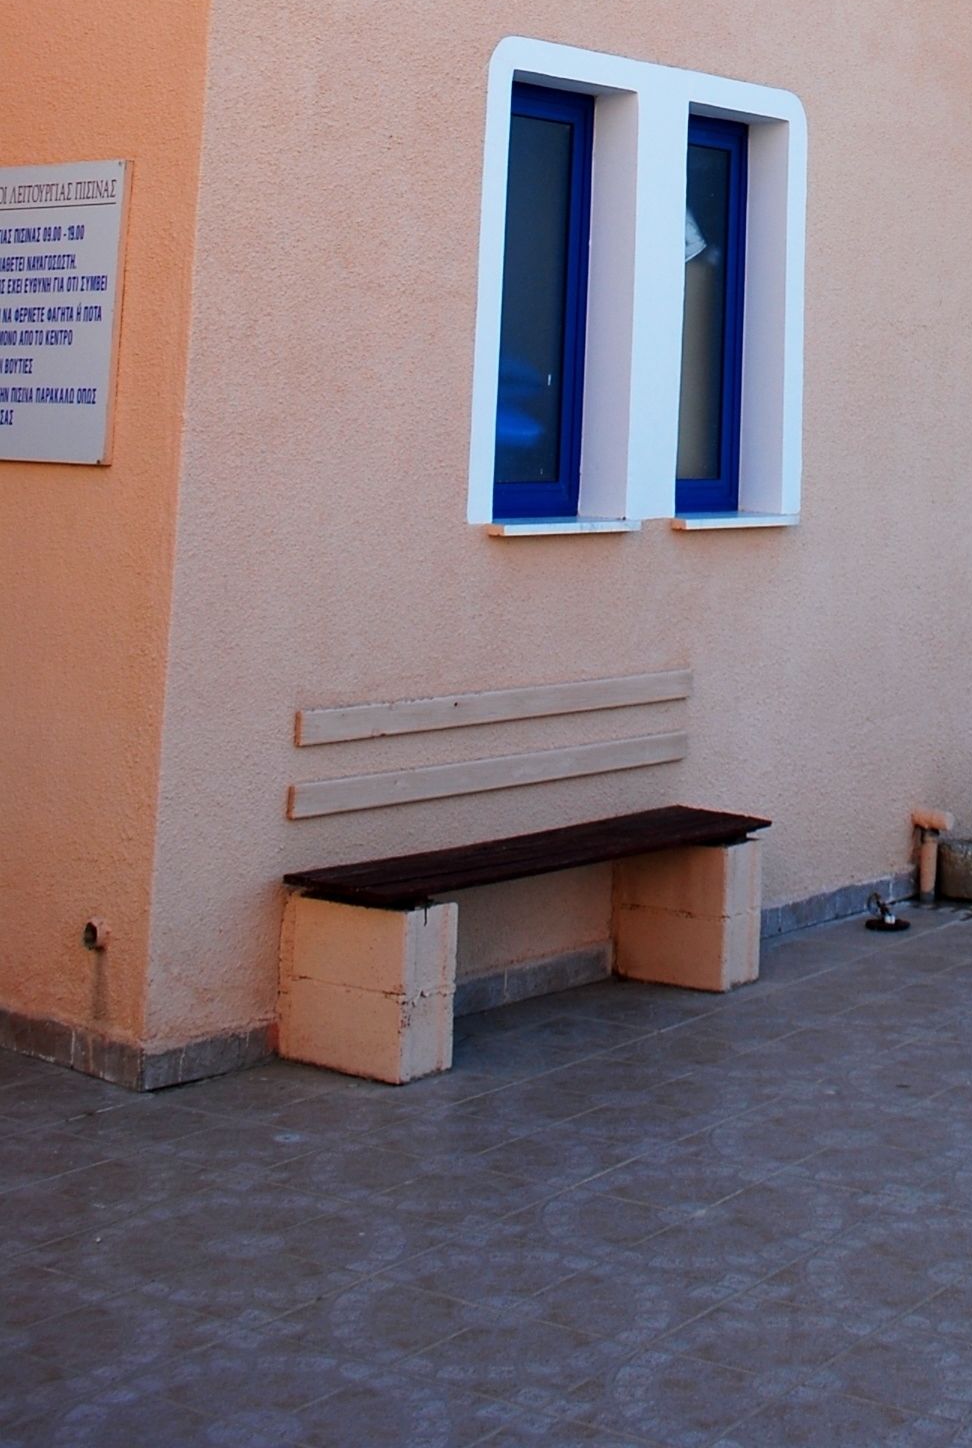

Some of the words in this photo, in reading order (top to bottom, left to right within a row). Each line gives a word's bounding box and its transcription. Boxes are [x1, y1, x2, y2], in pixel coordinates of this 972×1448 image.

[9, 182, 73, 204] ΛΕΙΤΟΥΡΓΙΑΣ
[74, 179, 117, 200] ΠΙΣΙΝΑΣ
[42, 225, 62, 242] 09.00
[7, 278, 23, 294] ΕΧΕΙ
[24, 277, 52, 293] ΕΥΘΥΝΗ
[53, 276, 65, 292] ΓΙΑ
[66, 276, 79, 292] ΟΤΙ
[14, 307, 45, 323] ΦΕΡΝΕΤΕ
[46, 306, 74, 322] ΦΑΓΗΤΑ
[83, 305, 102, 322] ΠΟΤΑ
[45, 329, 73, 346] ΚΕΝΤΡΟ
[35, 387, 75, 403] ΠΑΡΑΚΑΛΩ
